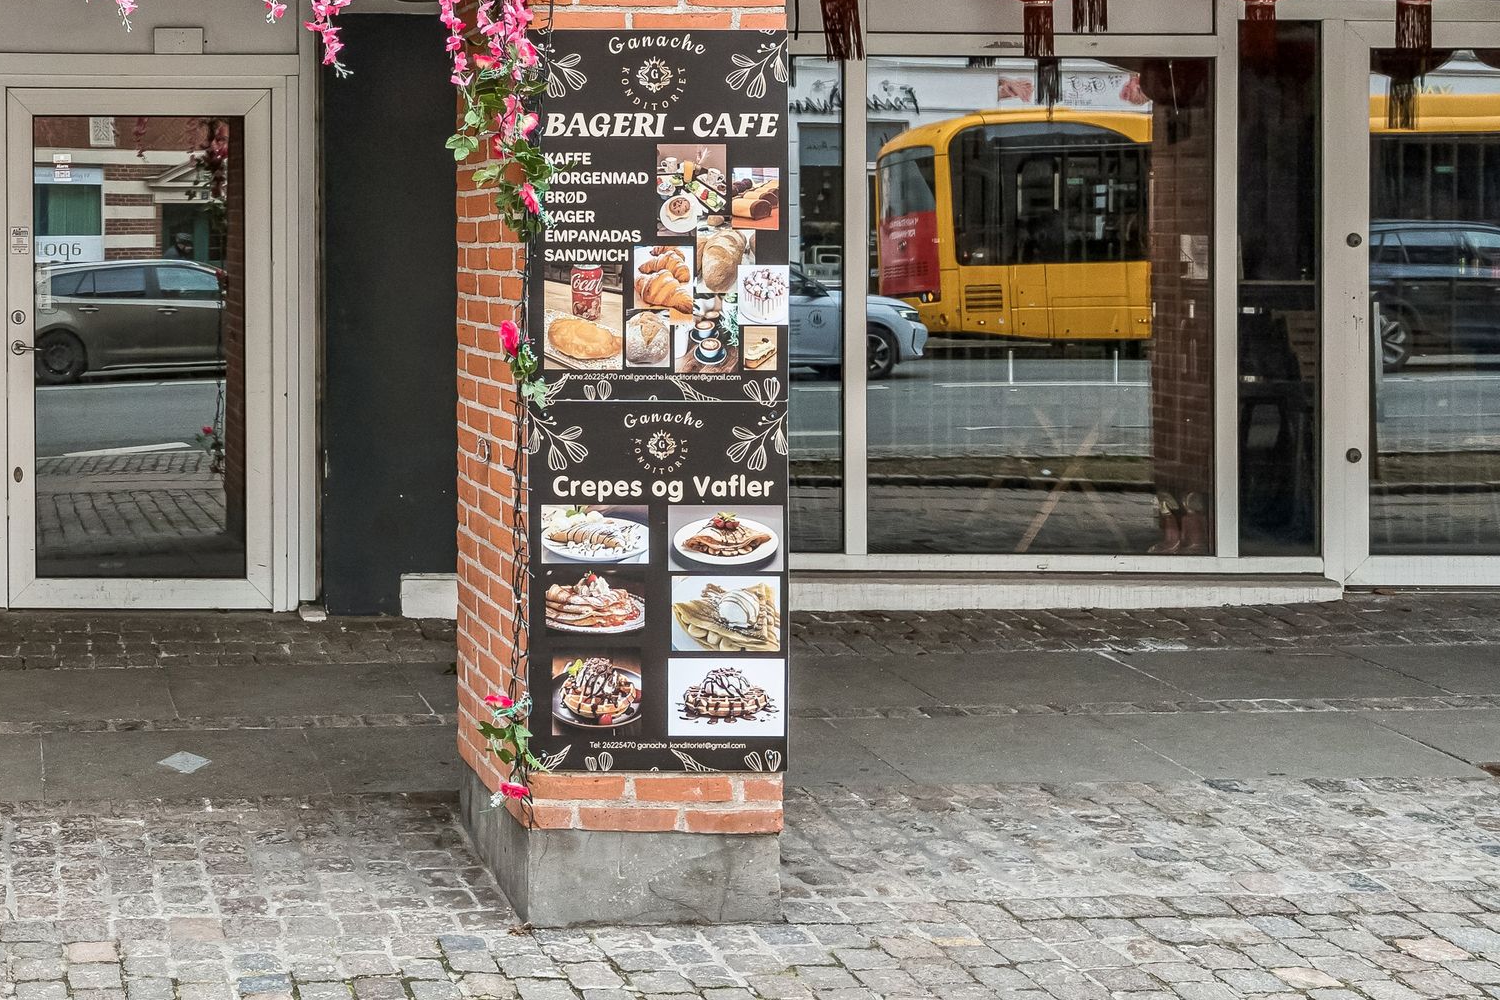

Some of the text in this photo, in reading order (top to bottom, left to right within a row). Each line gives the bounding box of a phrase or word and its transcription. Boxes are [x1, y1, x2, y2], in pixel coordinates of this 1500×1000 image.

[608, 33, 706, 55] Ganache
[621, 67, 687, 111] KONDITORIET
[543, 112, 668, 138] BAGERI
[692, 112, 780, 138] CAFE
[544, 152, 592, 165] KAFFE
[545, 171, 649, 185] MORGENMAD
[544, 191, 588, 204] BRØD
[545, 210, 595, 223] KAGER
[544, 229, 642, 243] EMPANADAS
[544, 248, 629, 262] SANDWICH
[624, 411, 704, 428] Ganache
[634, 438, 688, 475] KONDITORIET
[552, 474, 775, 502] Crepes og Vafler
[602, 741, 636, 749] 26225470
[637, 743, 668, 751] ganache
